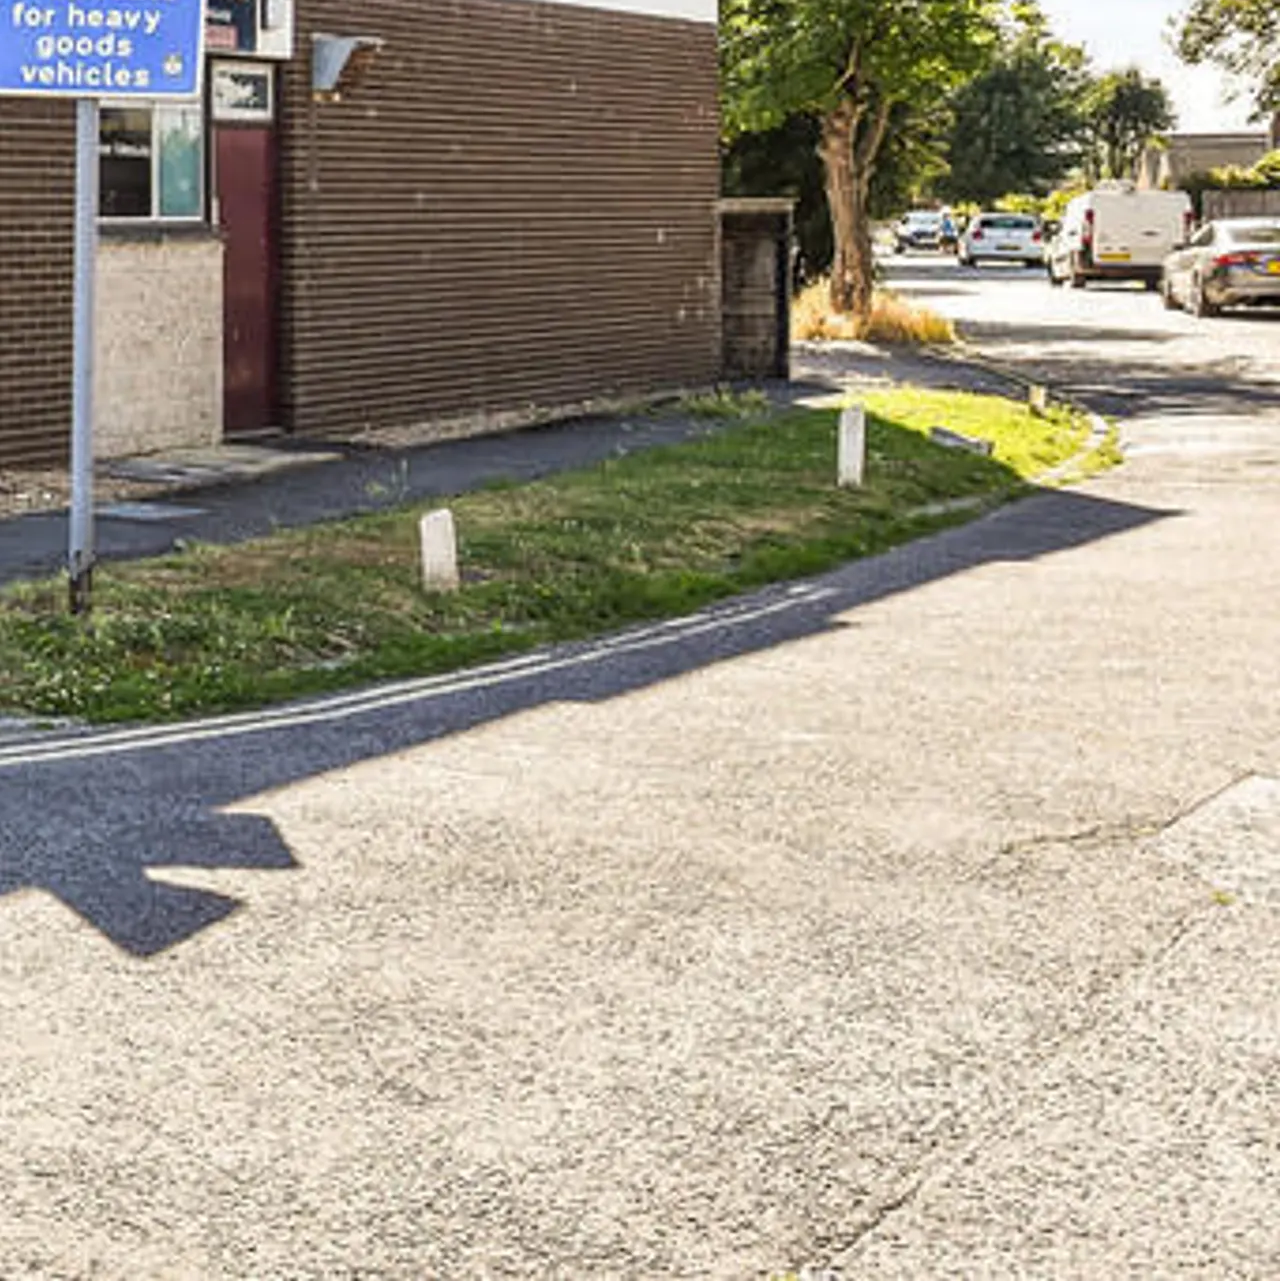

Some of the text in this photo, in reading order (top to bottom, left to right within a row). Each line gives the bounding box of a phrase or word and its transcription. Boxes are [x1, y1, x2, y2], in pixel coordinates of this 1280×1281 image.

[12, 2, 161, 34] for heavy
[36, 33, 132, 59] goods
[20, 61, 150, 86] vehicles
